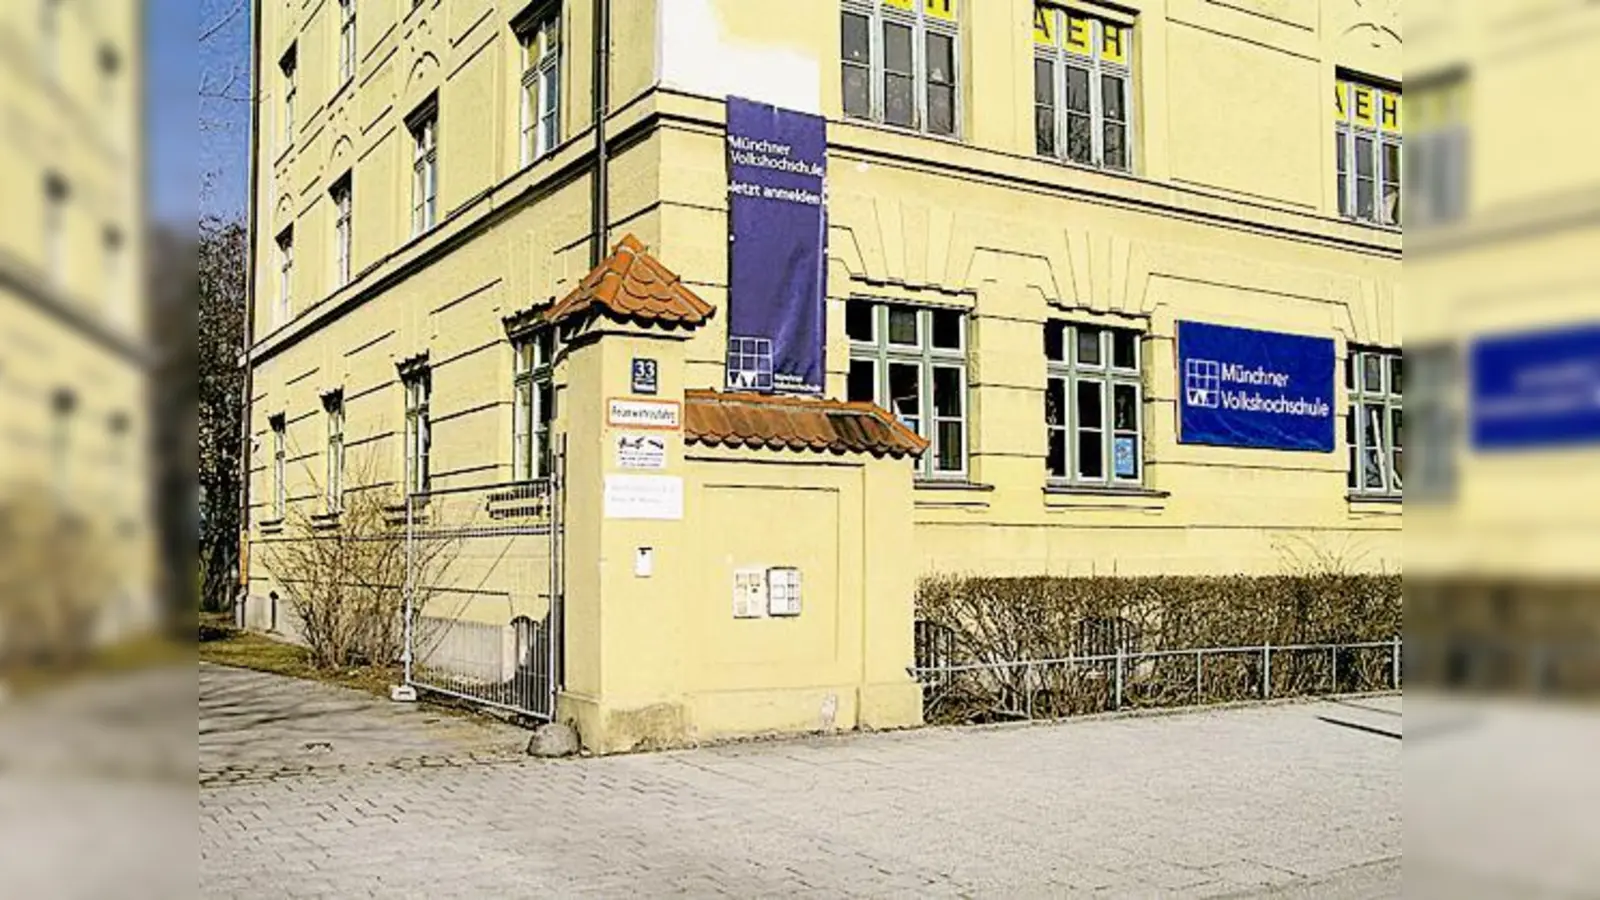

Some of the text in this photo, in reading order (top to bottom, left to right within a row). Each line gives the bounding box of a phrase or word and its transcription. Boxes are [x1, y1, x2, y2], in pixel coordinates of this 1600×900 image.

[728, 135, 791, 155] Münchner
[731, 150, 824, 177] Volkshochschule
[763, 186, 820, 204] anmelden
[635, 360, 656, 378] 33
[1221, 362, 1290, 388] Münchner
[1221, 390, 1330, 418] Volkshochschule
